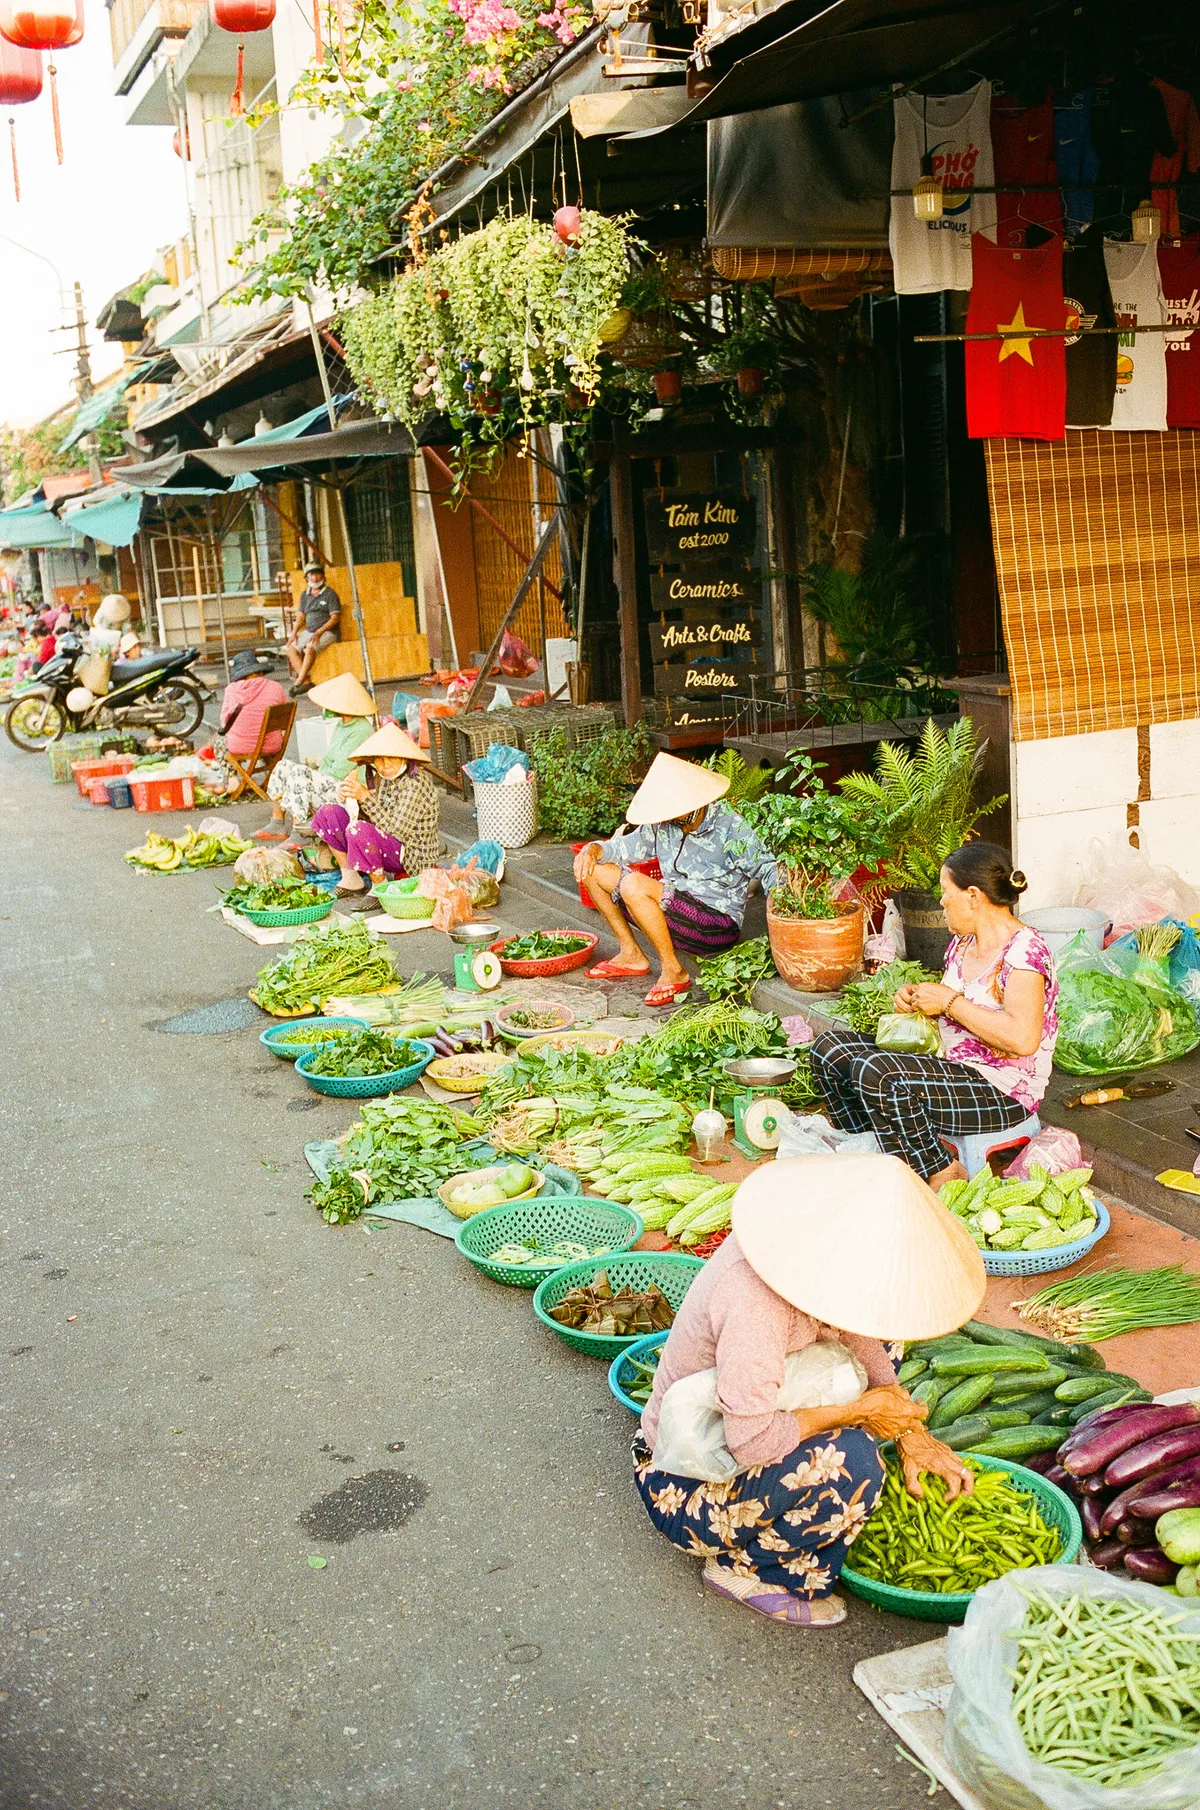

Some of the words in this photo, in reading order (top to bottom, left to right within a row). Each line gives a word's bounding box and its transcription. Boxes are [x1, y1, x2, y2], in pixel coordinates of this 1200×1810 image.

[928, 220, 967, 232] ELICIOUS
[1125, 303, 1137, 312] THE
[1166, 298, 1188, 309] ust
[665, 504, 699, 527] Tám
[704, 501, 739, 524] Kim
[700, 532, 729, 546] 2000
[670, 579, 744, 599] Ceramics
[685, 669, 738, 688] Posters
